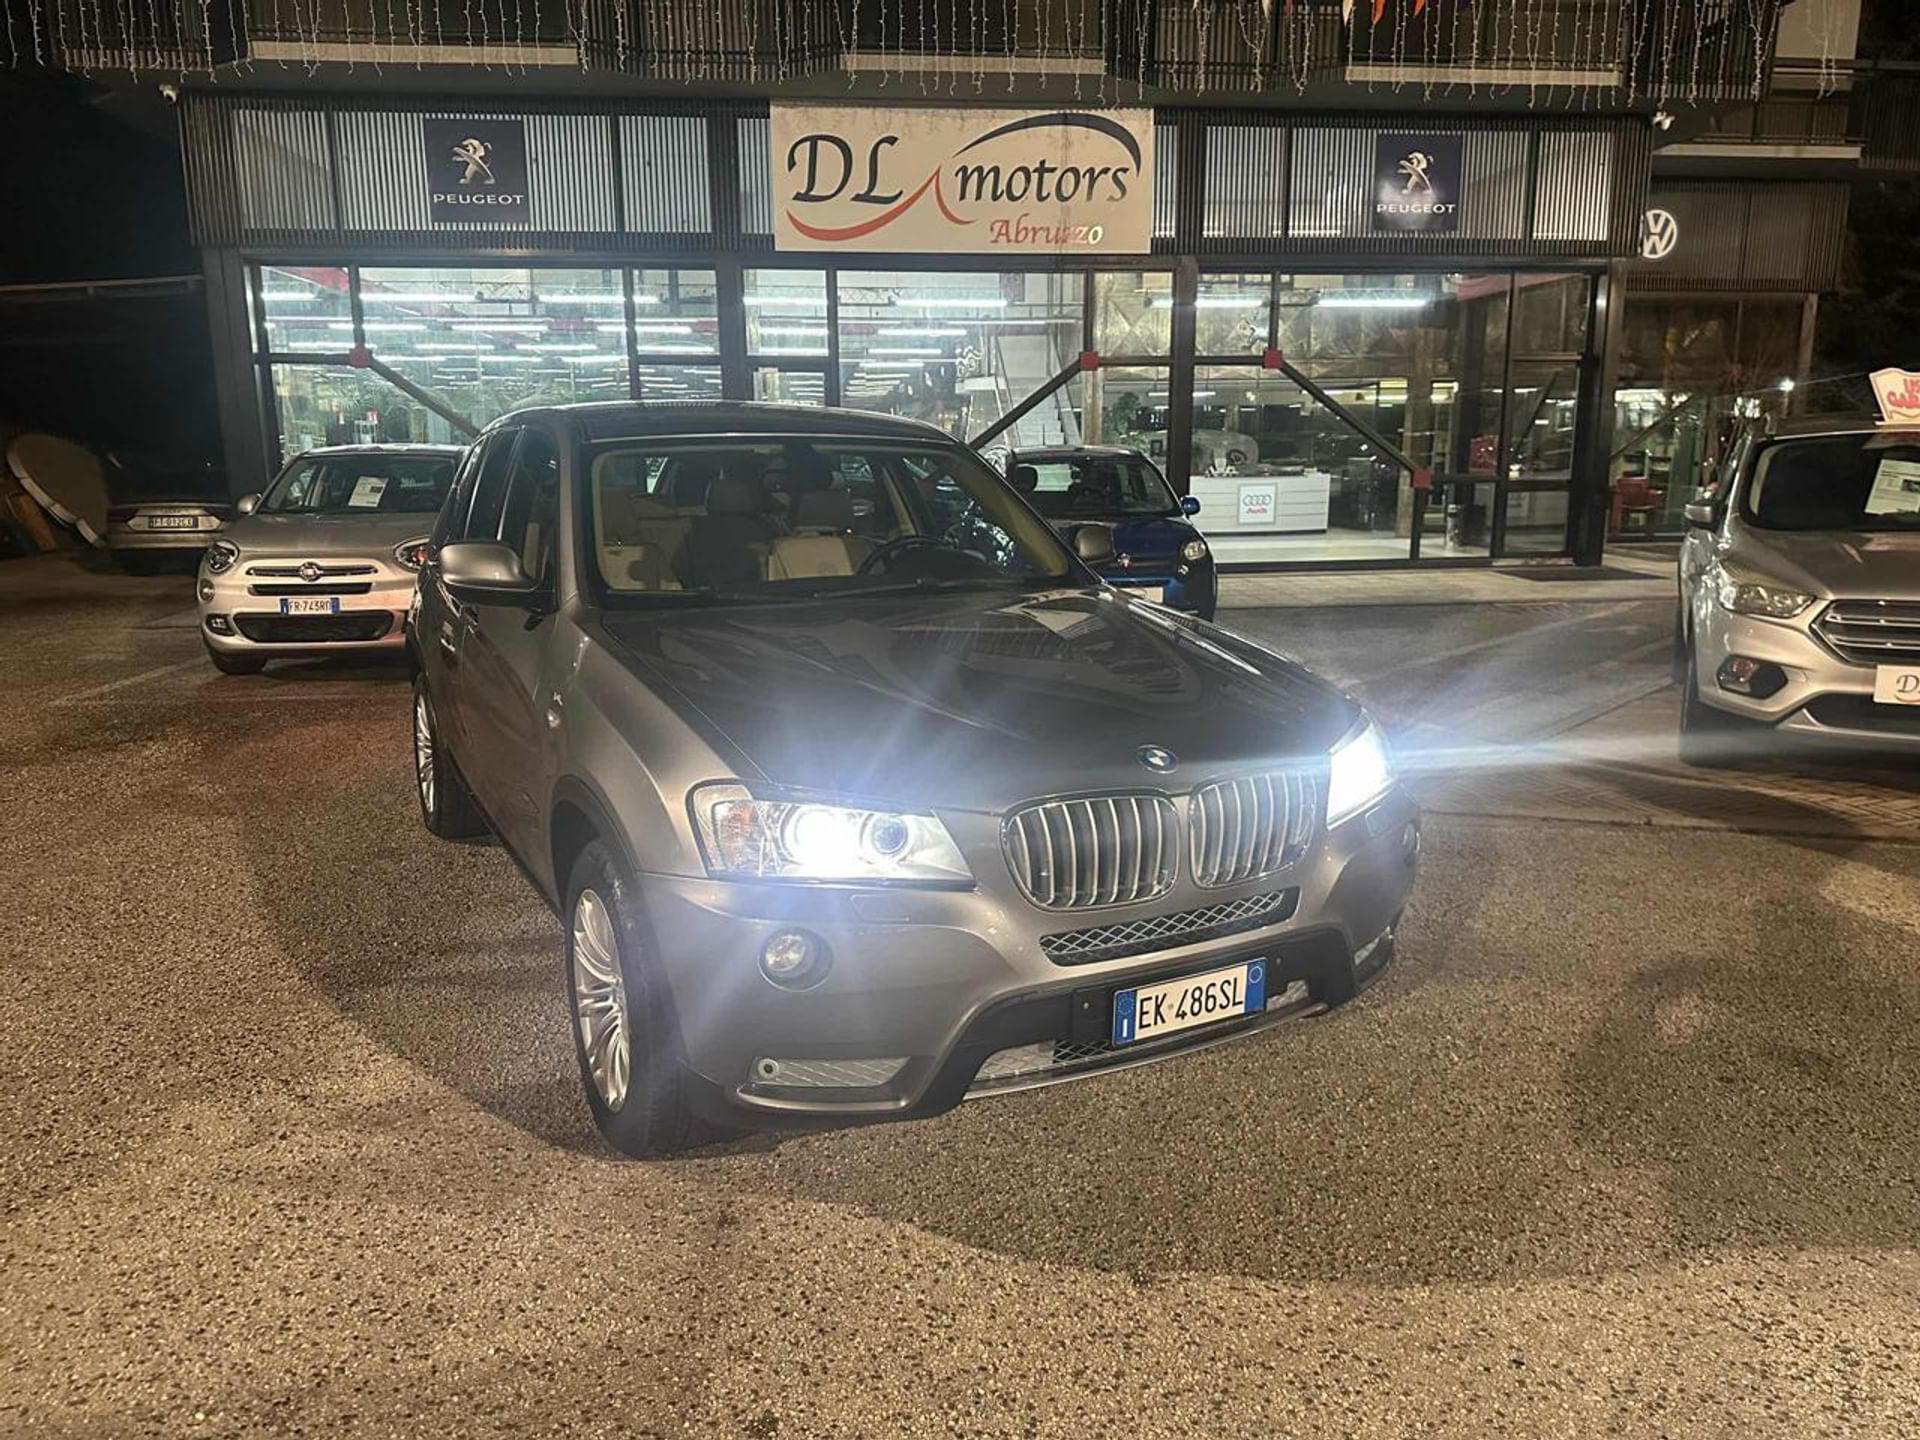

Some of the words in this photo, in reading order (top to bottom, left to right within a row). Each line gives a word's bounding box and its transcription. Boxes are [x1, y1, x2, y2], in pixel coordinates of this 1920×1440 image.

[787, 134, 903, 204] DL
[954, 158, 1130, 203] motors
[433, 193, 524, 205] PEUGEOT
[1376, 203, 1456, 213] PEUGEOT
[989, 212, 1103, 245] Abruzzo
[1896, 674, 1920, 693] D
[1138, 992, 1167, 1030] EK
[1174, 977, 1243, 1021] 486SL
[1122, 1018, 1128, 1037] I
